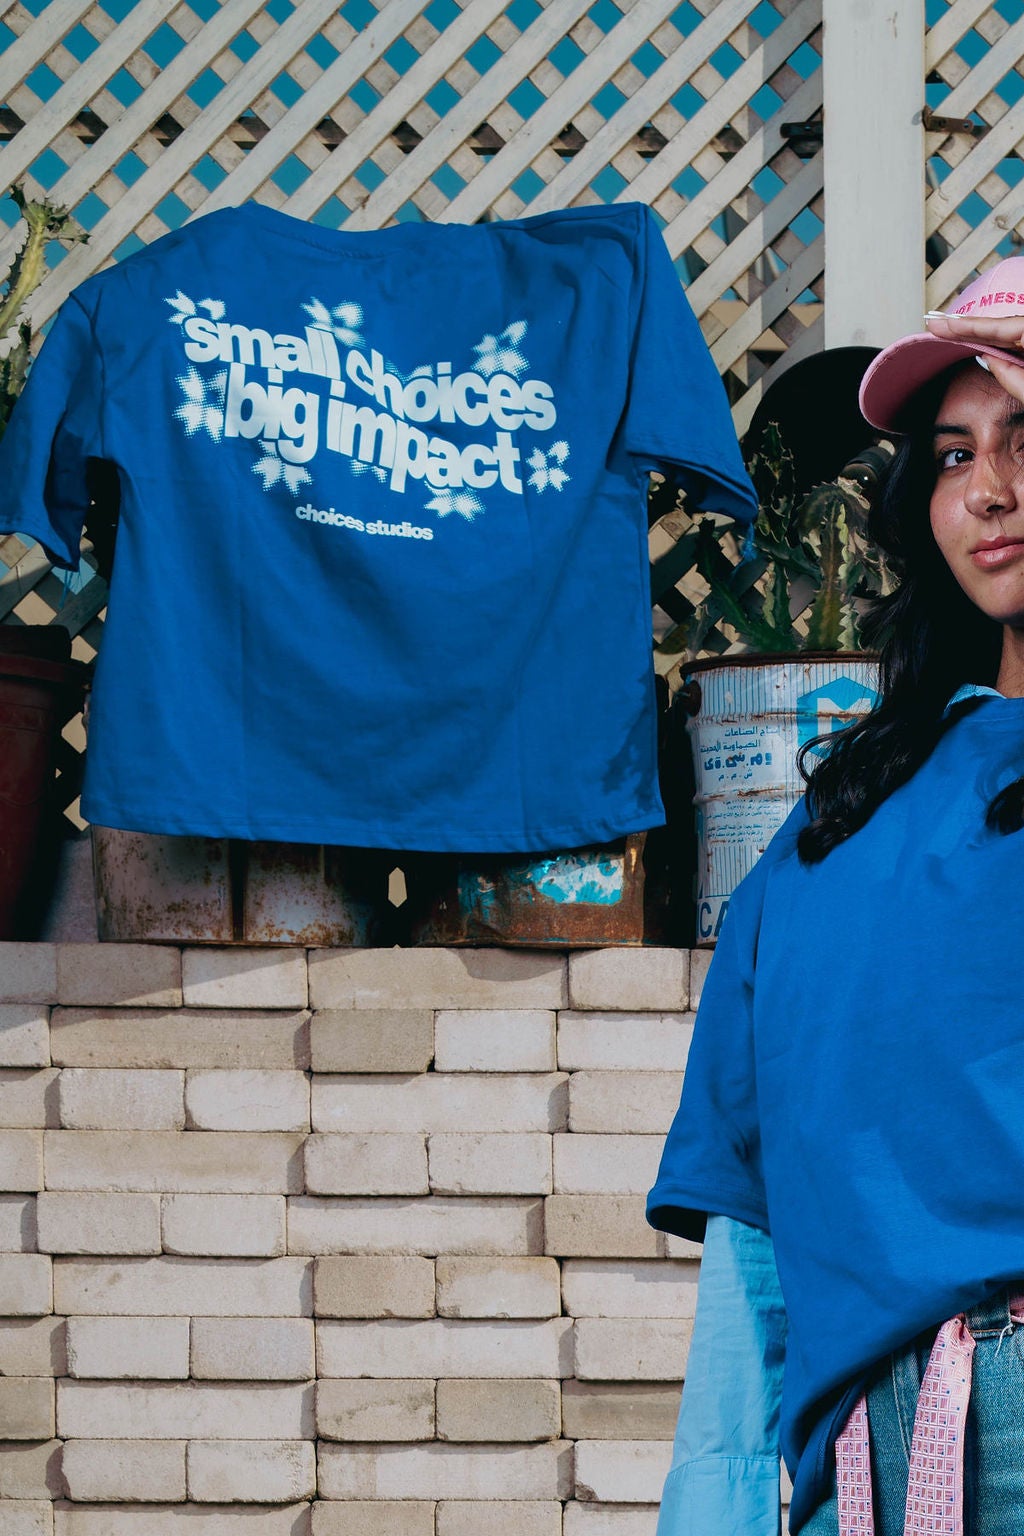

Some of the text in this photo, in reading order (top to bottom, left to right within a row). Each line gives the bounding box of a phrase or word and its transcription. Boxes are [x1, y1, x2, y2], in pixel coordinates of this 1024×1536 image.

[184, 317, 557, 431] small choices
[224, 362, 523, 494] big impact
[295, 503, 434, 540] choices studios
